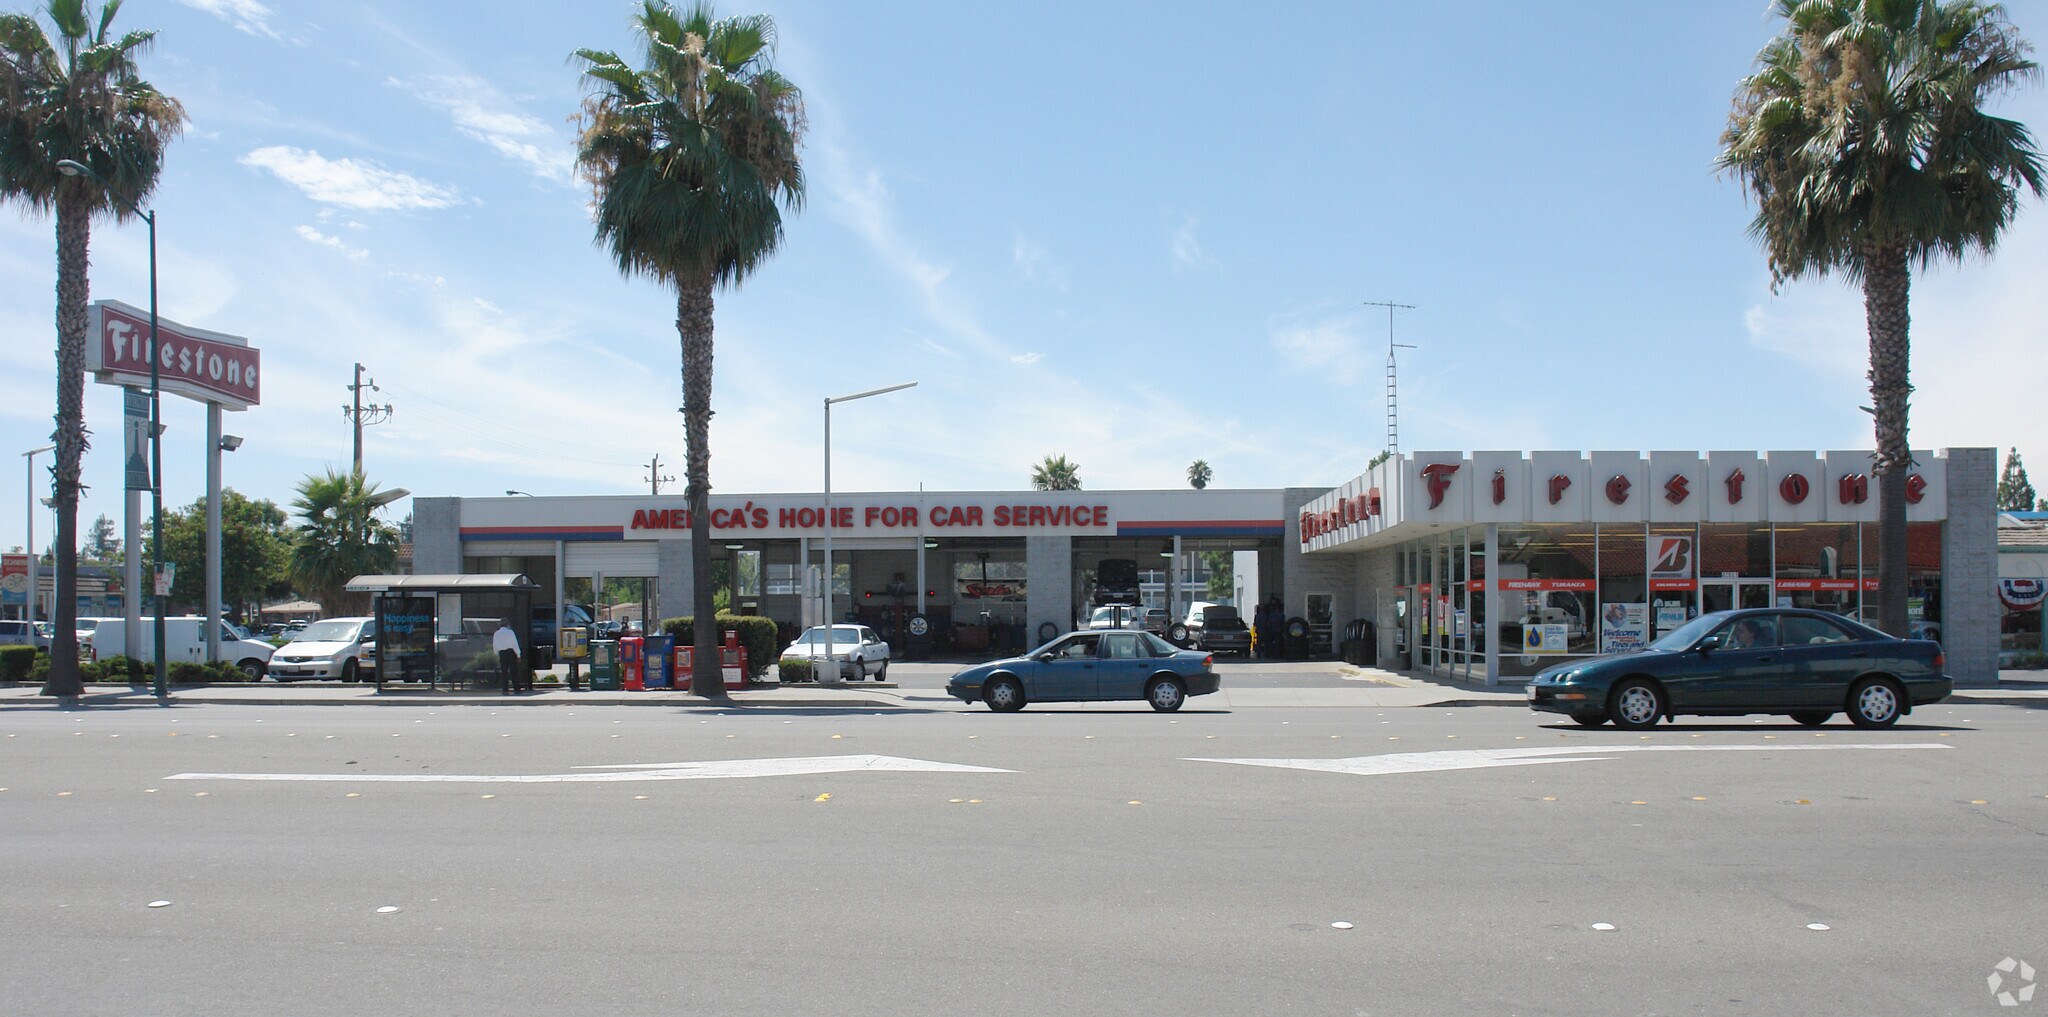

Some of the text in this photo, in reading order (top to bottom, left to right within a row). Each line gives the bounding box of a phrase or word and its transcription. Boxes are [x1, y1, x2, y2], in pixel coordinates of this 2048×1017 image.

[107, 319, 257, 389] Firestone
[1420, 463, 1927, 511] Firestone
[631, 501, 1109, 529] AMECA'S HOME FOR CAR SERVICE
[384, 613, 430, 624] Happiness
[1604, 629, 1641, 637] Welcome
